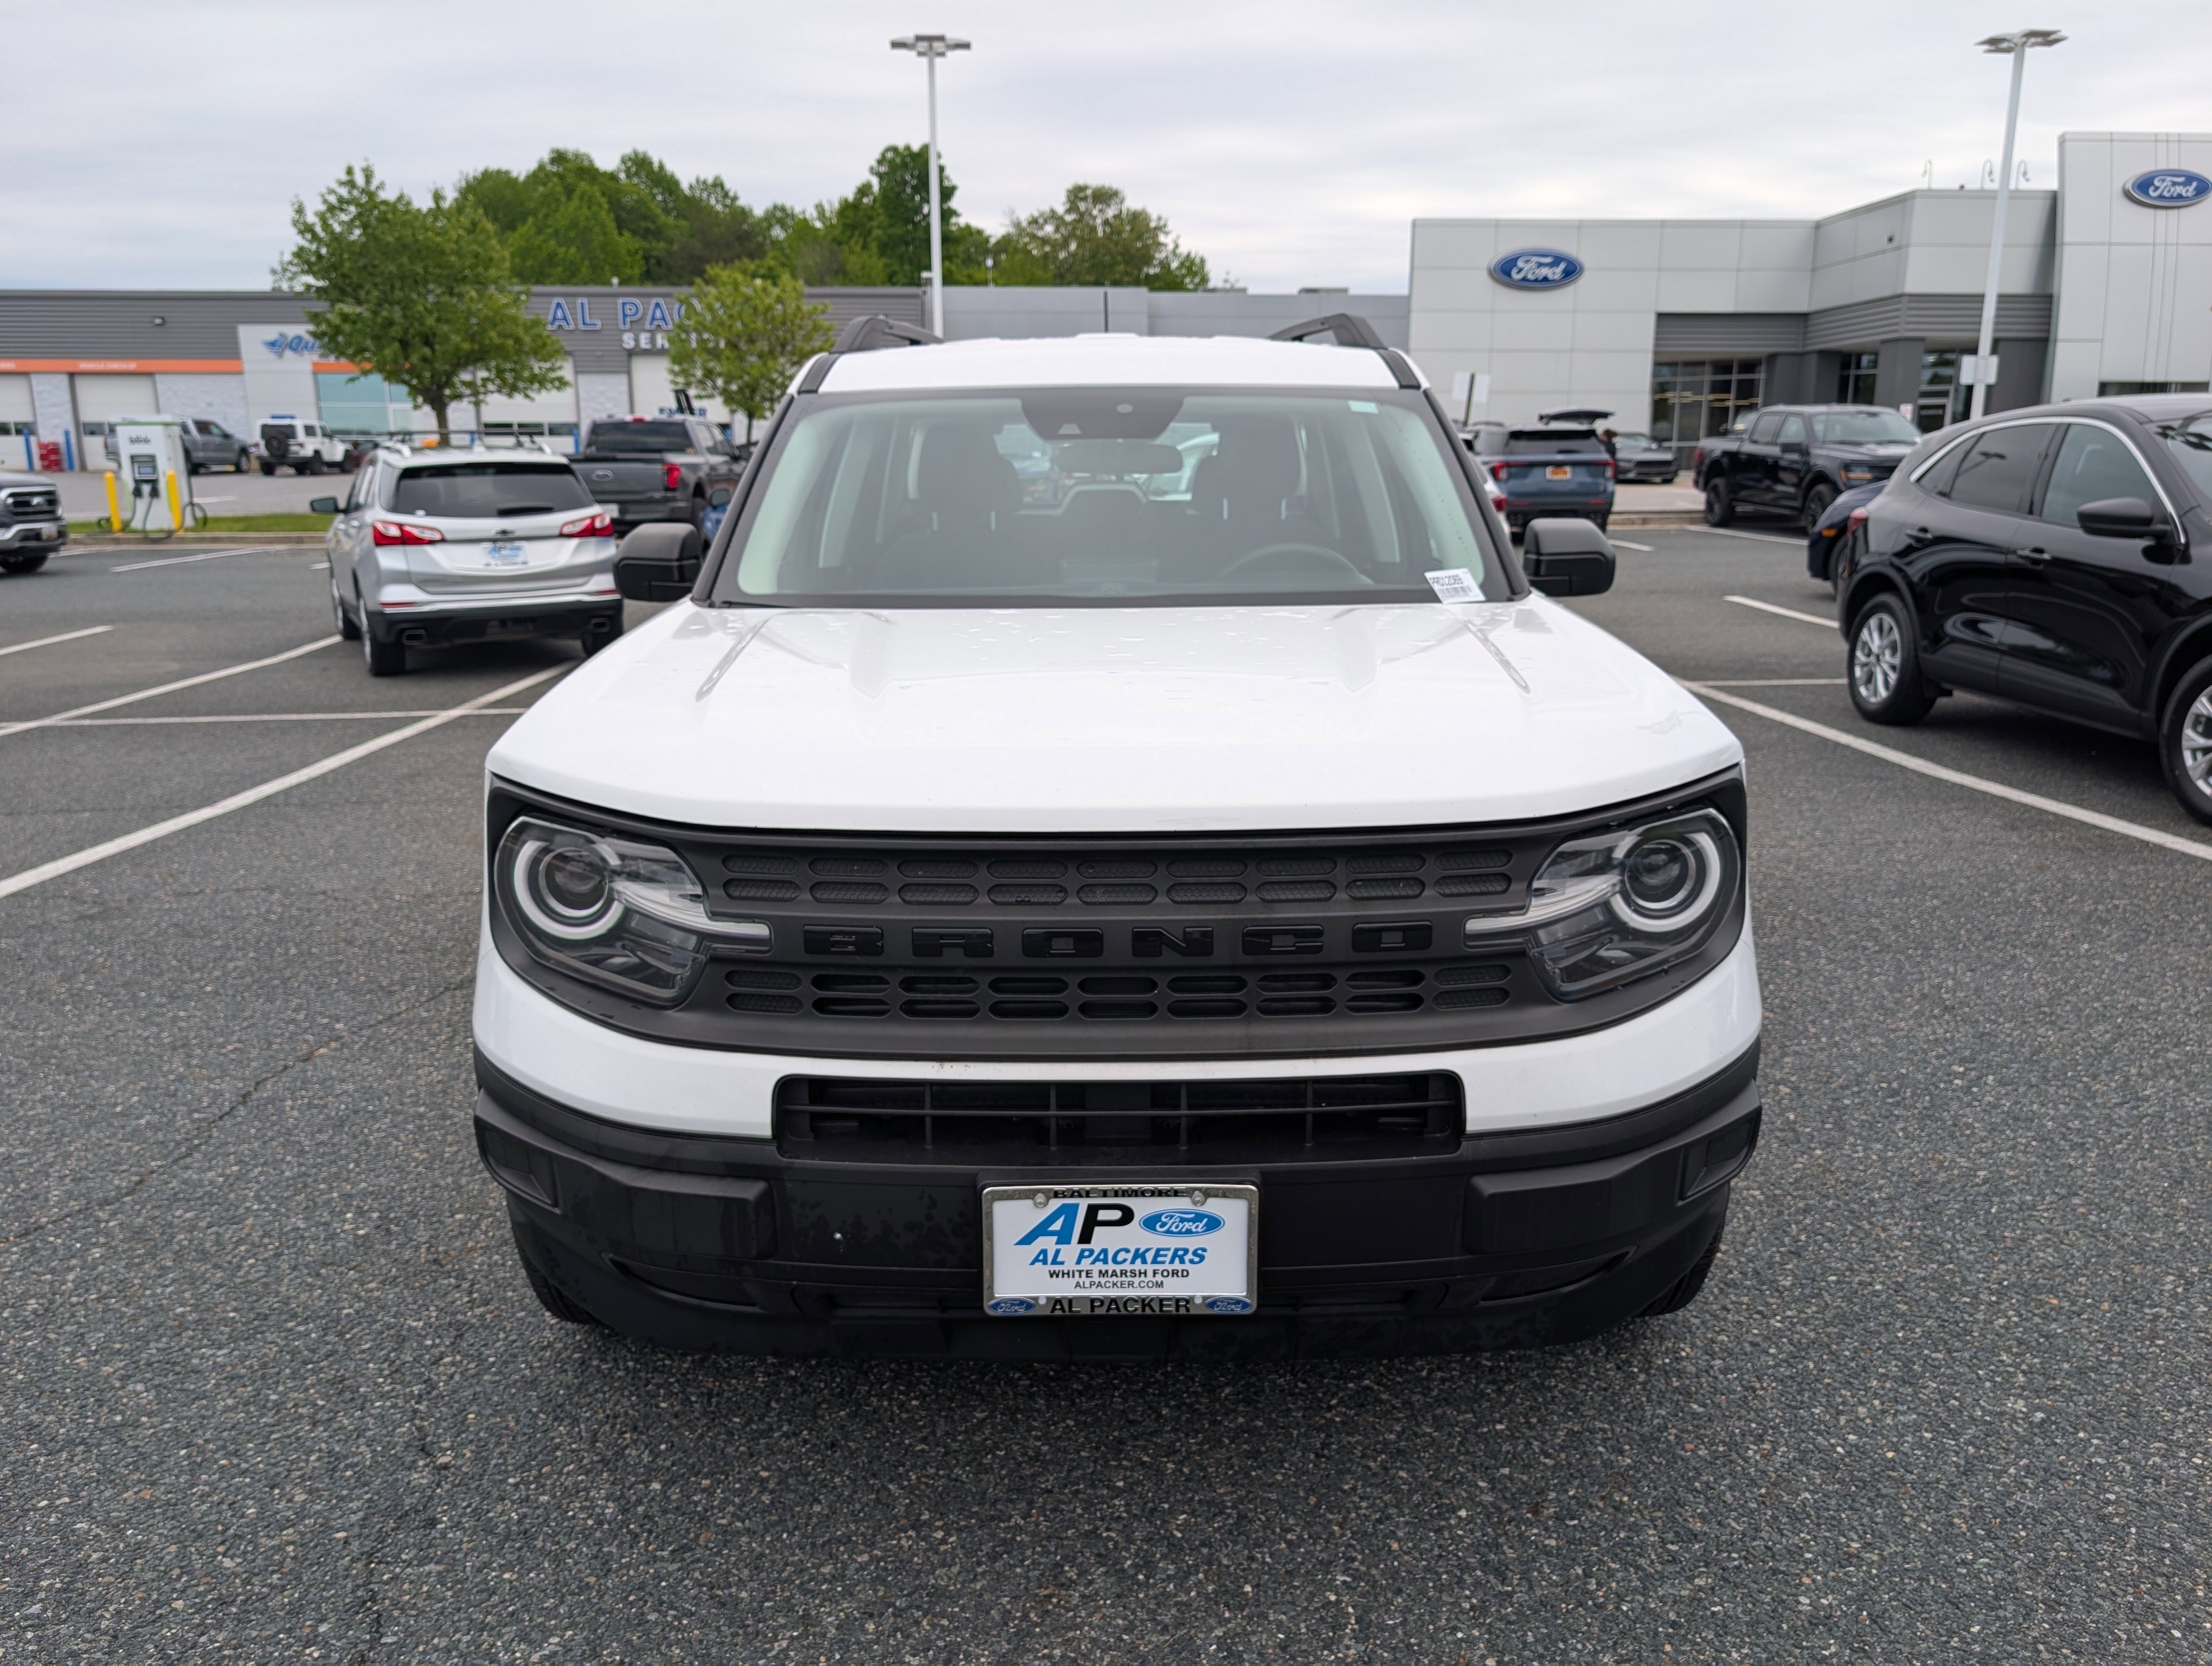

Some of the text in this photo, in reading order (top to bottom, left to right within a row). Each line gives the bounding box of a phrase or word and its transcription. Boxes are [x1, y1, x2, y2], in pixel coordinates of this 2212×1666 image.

[2149, 176, 2197, 197] Ford
[1511, 255, 1568, 281] Ford
[546, 297, 602, 330] AL
[803, 922, 1432, 957] BRONCO
[1053, 1187, 1187, 1197] BALTIMORE
[1013, 1202, 1135, 1246] AP
[1155, 1213, 1207, 1233] Ford
[1028, 1247, 1208, 1265] AL PACKERS
[1048, 1269, 1189, 1278] WHITE MARSH FORD
[1073, 1280, 1164, 1289] ALPACKER.COM
[996, 1302, 1026, 1313] Ford
[1050, 1296, 1190, 1313] AL PACKER
[1213, 1301, 1243, 1312] Ford
